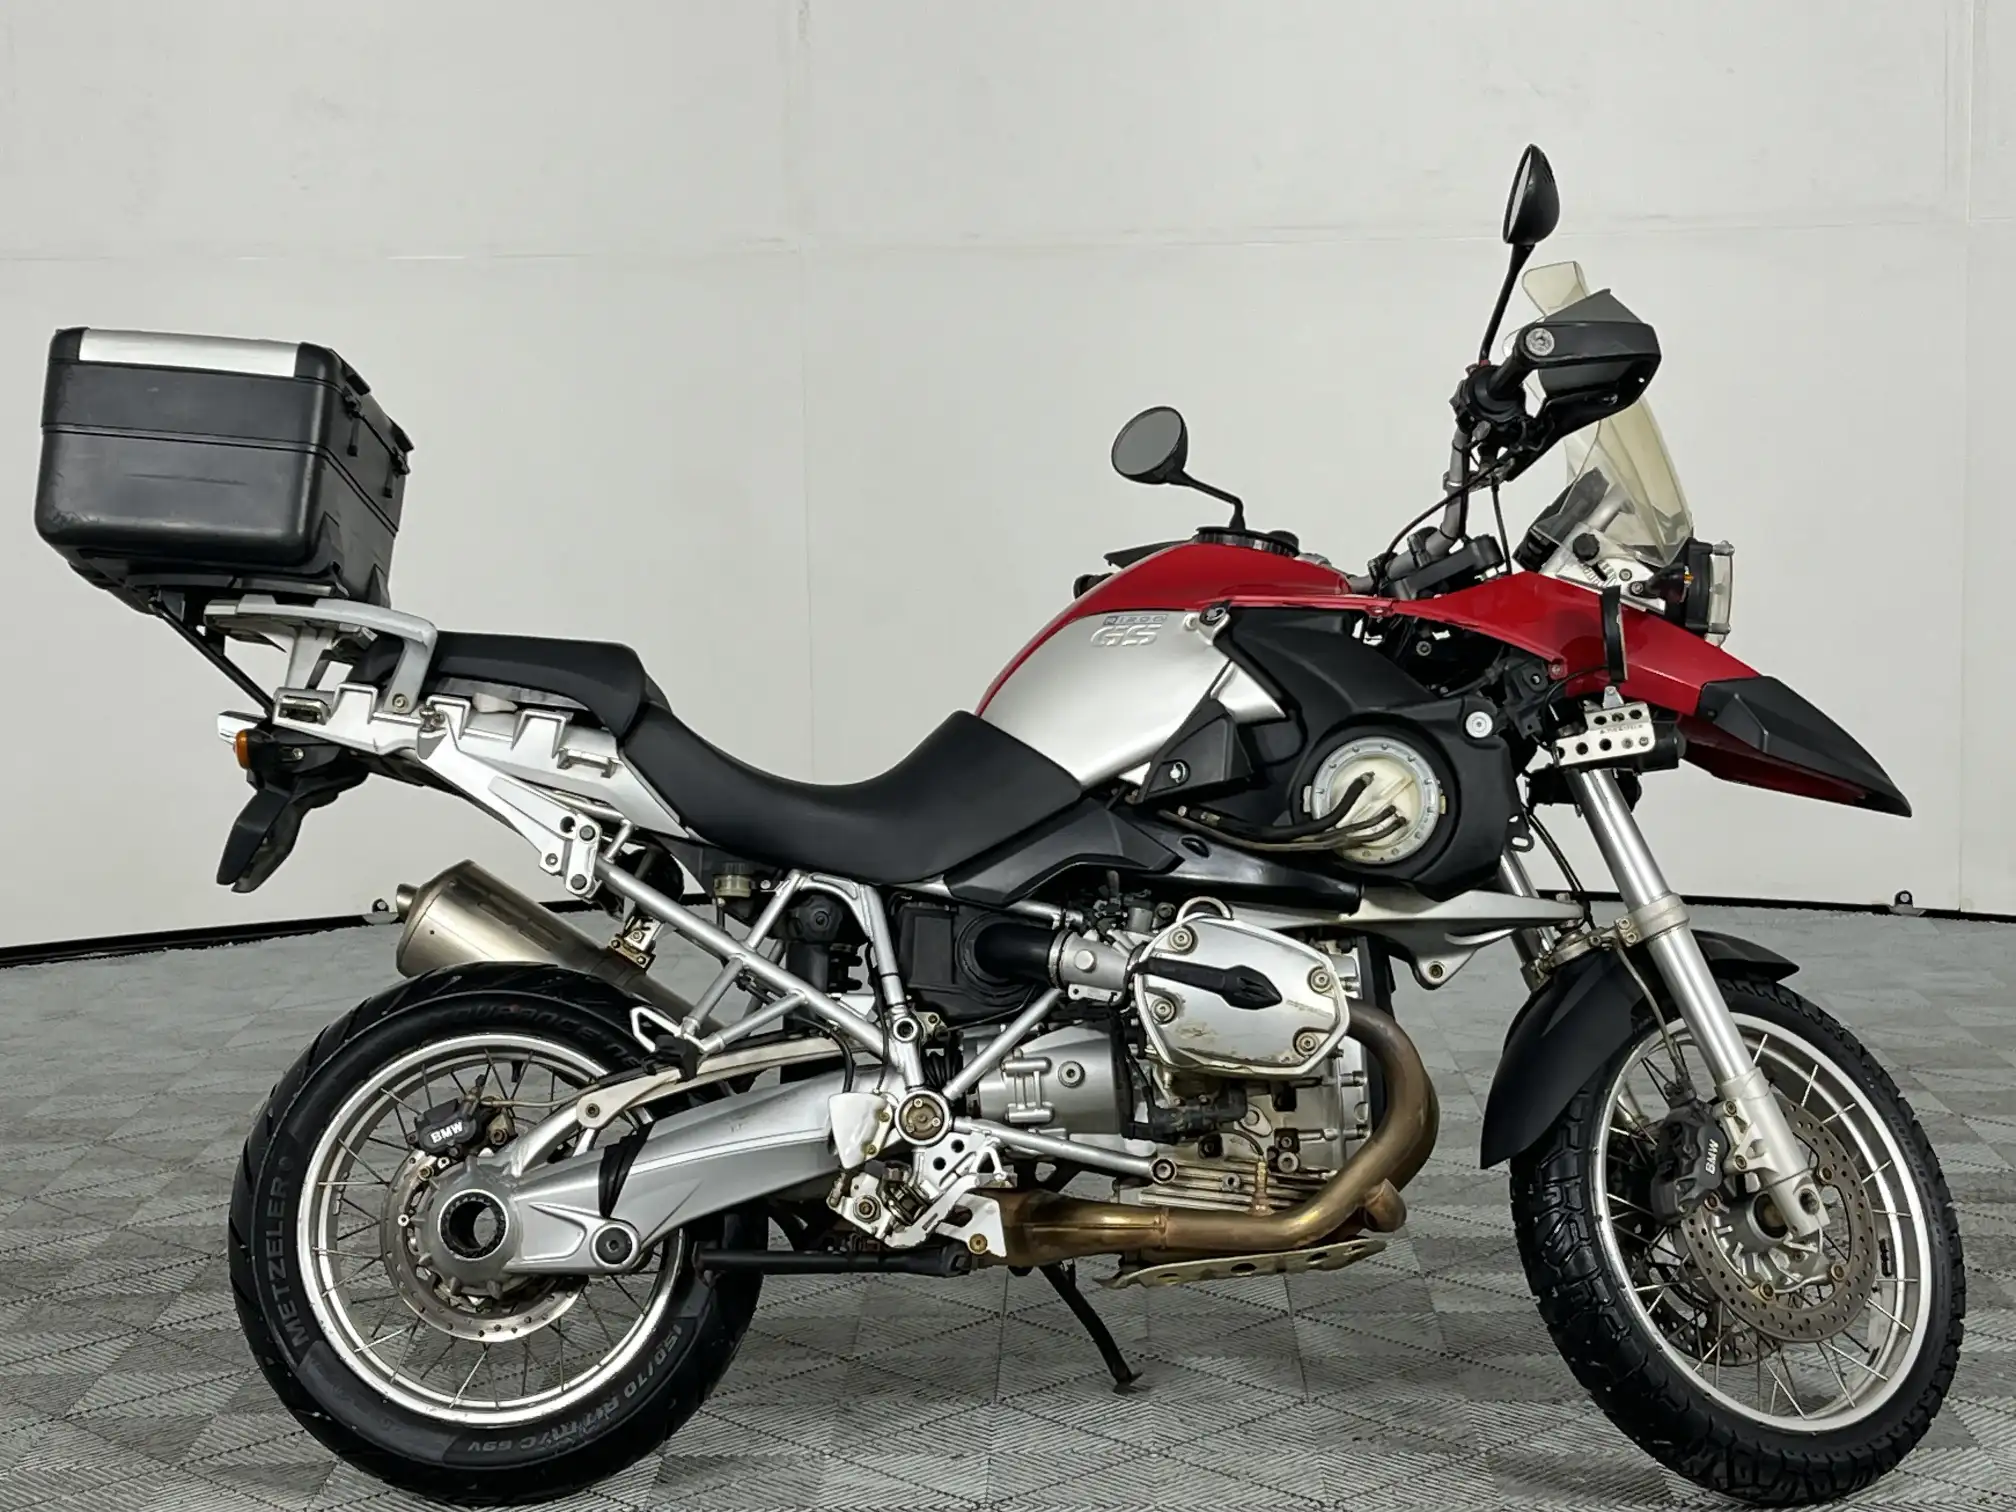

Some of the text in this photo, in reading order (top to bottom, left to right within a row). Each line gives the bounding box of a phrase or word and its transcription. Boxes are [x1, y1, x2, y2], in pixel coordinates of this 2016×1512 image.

[1090, 624, 1162, 647] GS
[430, 1120, 463, 1144] BMW
[1705, 1138, 1719, 1175] BMW
[265, 1177, 309, 1347] METZELER
[624, 1324, 682, 1399] 150/70
[466, 1438, 514, 1452] 69V
